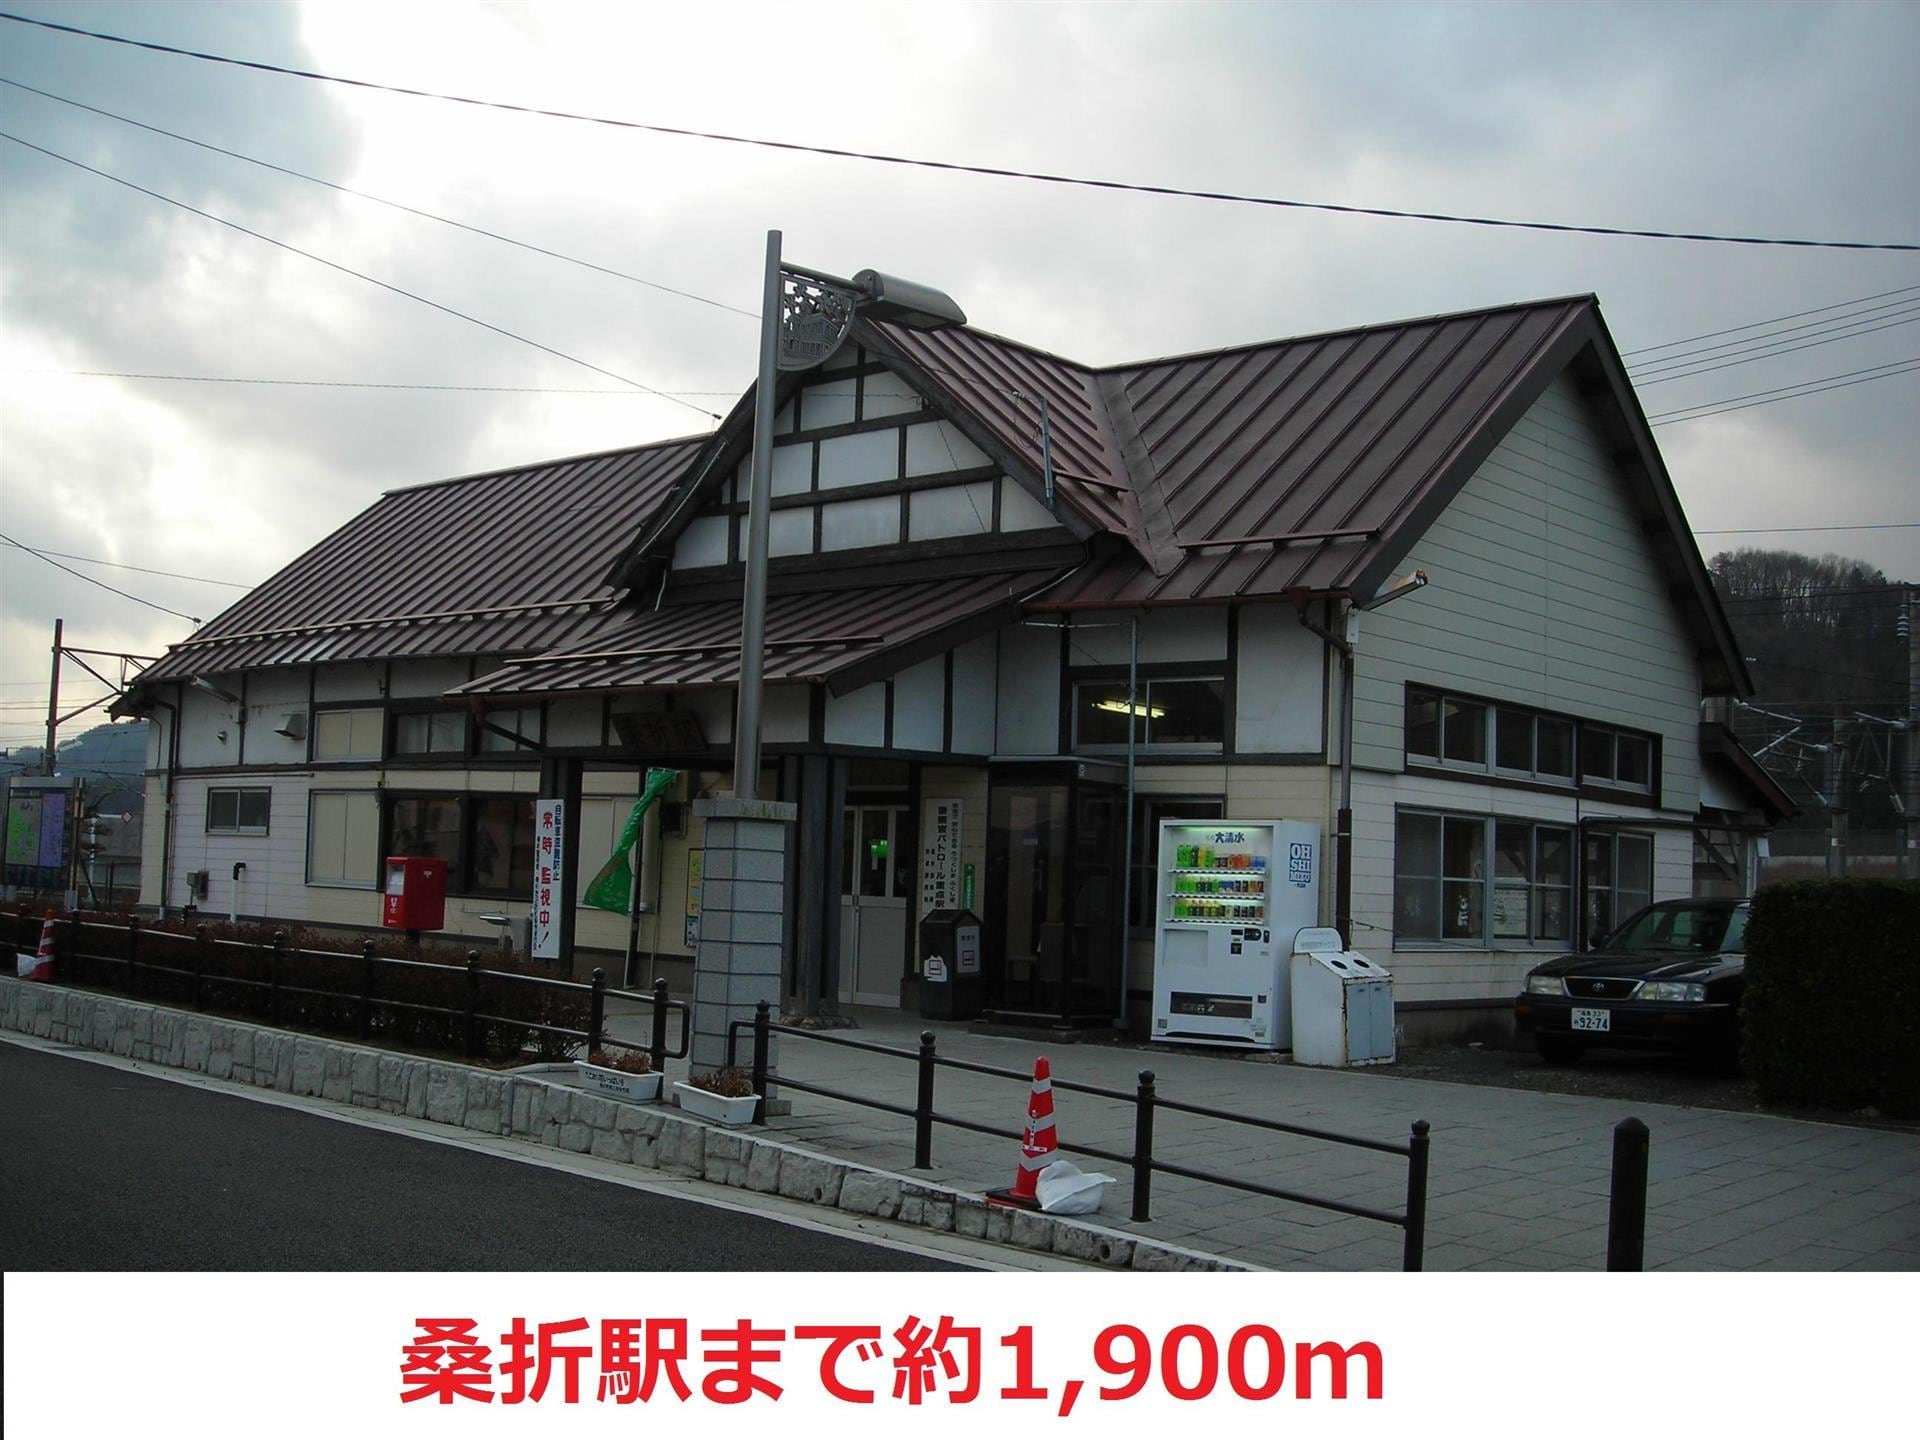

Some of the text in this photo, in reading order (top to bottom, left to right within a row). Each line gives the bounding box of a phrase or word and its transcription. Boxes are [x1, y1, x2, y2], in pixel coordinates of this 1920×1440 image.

[1214, 831, 1245, 844] 大清水
[1291, 844, 1312, 859] OH
[1290, 859, 1311, 872] SHI
[1579, 1017, 1608, 1030] 92-74
